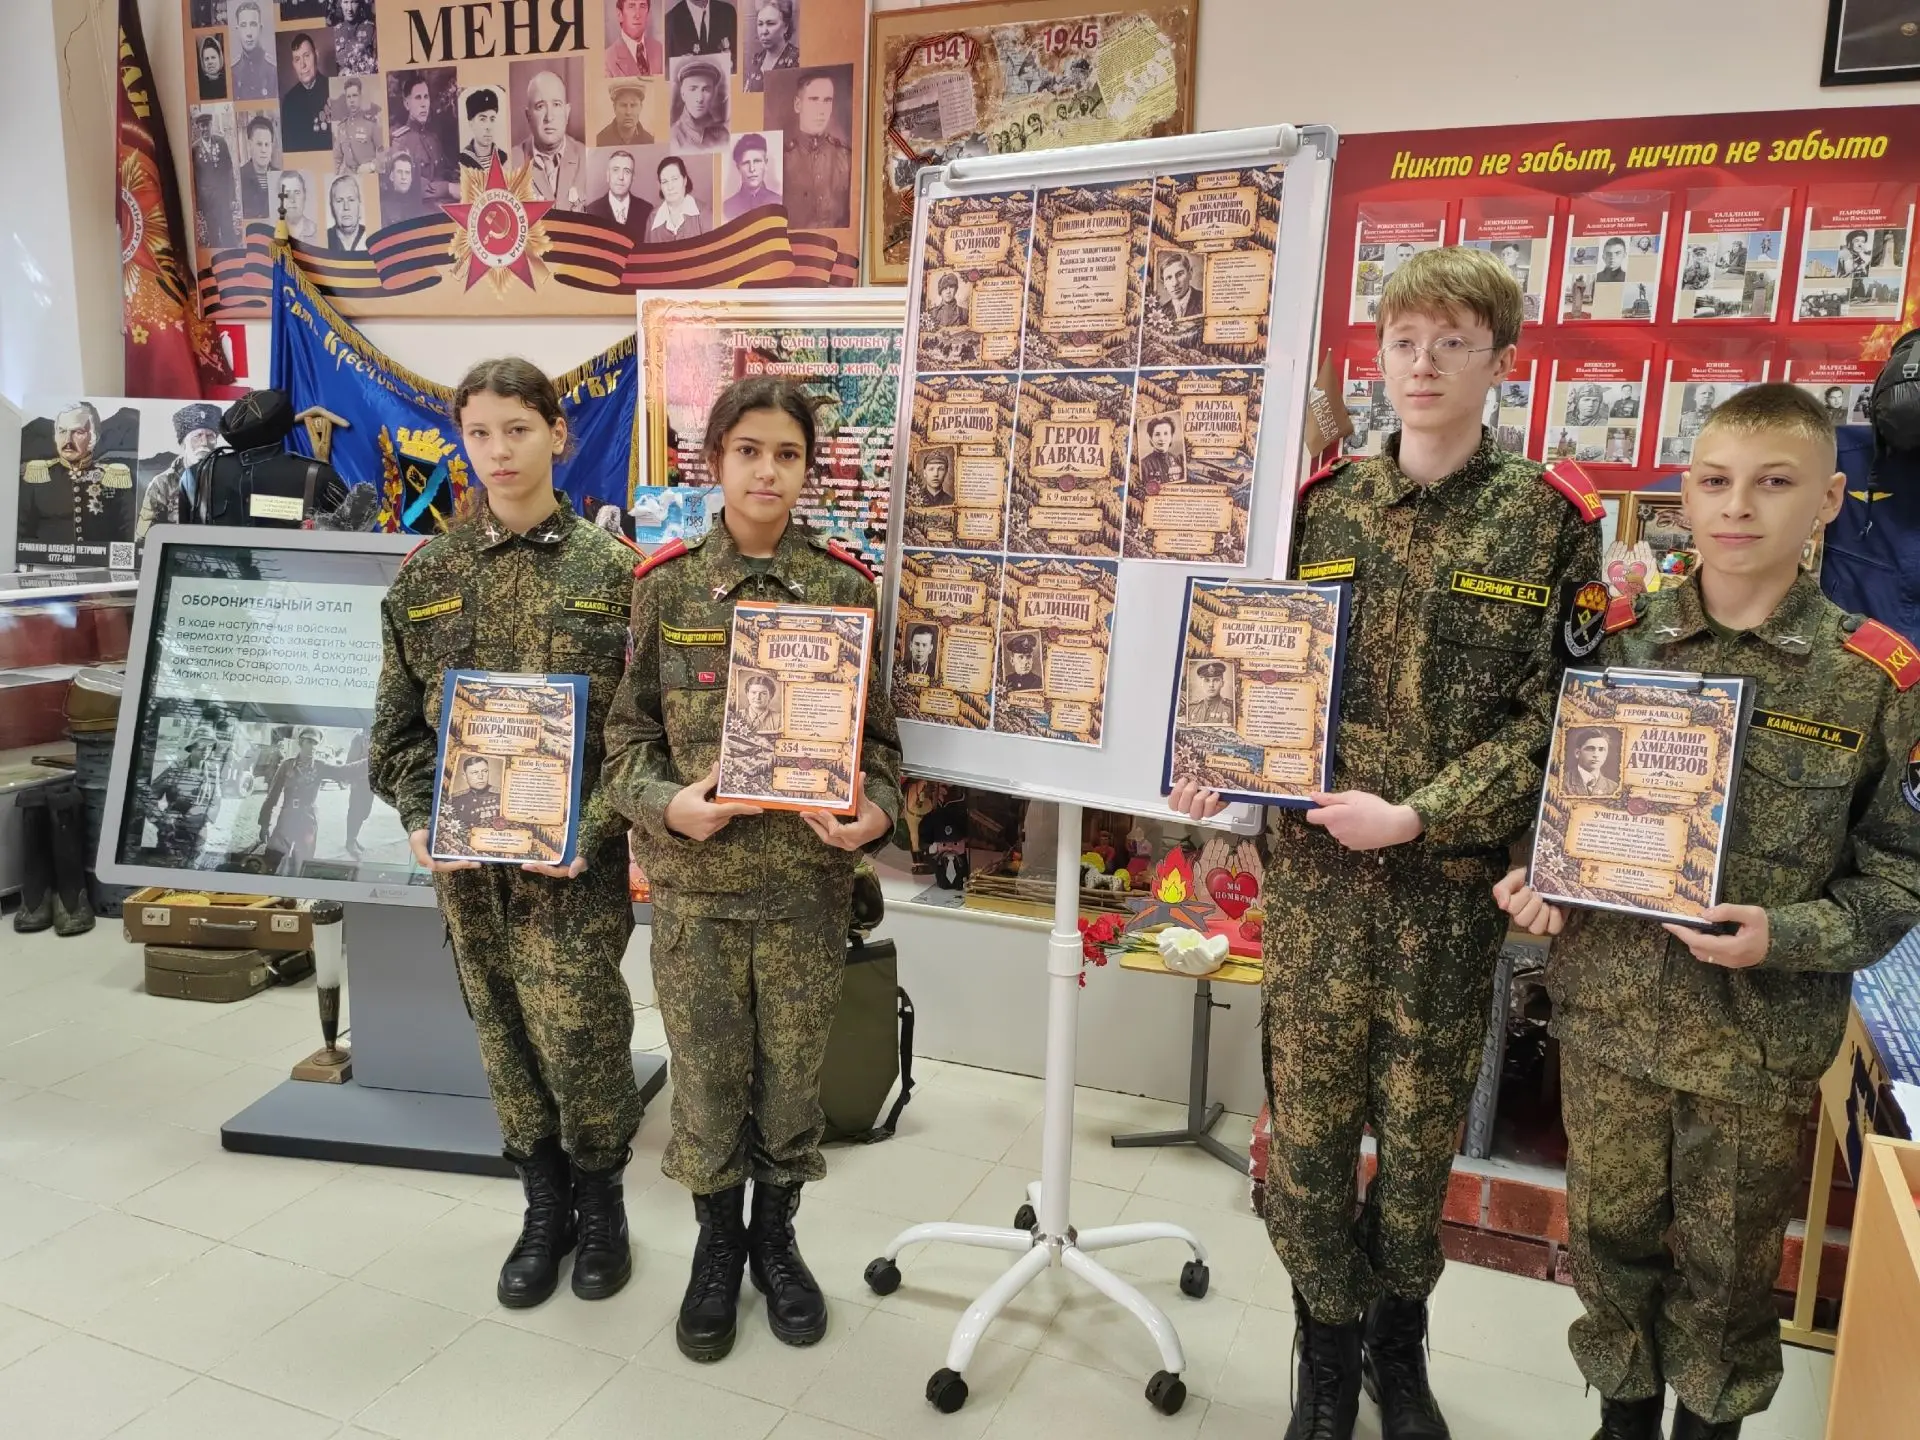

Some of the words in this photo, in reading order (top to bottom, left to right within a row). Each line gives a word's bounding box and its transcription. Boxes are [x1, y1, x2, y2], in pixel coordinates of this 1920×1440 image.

[403, 0, 590, 64] МЕНЯ
[1043, 24, 1099, 54] 1945
[922, 37, 973, 65] 1941
[1390, 150, 1472, 180] Никто
[1479, 150, 1511, 177] не
[1517, 142, 1618, 176] забыт,
[1627, 138, 1718, 169] ничто
[1724, 135, 1760, 165] не
[1767, 128, 1890, 163] забыто
[1198, 192, 1237, 202] АЛЕКСАНДР
[1189, 201, 1243, 211] ПОЛИКАРПОВИЧ
[1056, 219, 1085, 232] ПОМНИМ
[1086, 219, 1092, 228] И
[1092, 216, 1127, 228] ГОРДИМСЯ
[1180, 210, 1251, 232] КИРИЧЕНКО
[510, 216, 526, 257] ВОЙНА
[950, 229, 975, 239] ЦЕЗАРЬ
[976, 226, 1007, 237] ЛЬВОВИЧ
[955, 237, 1001, 252] КУНИКОВ
[1057, 248, 1081, 257] Подвиг
[1060, 257, 1085, 265] Кавказа
[1087, 256, 1116, 265] навсегда
[1058, 266, 1088, 275] останется
[1095, 265, 1116, 273] нашей
[726, 332, 777, 352] «Пусть
[781, 336, 814, 352] один
[819, 335, 828, 348] я
[832, 336, 889, 352] погибну
[746, 363, 763, 374] но
[767, 362, 839, 374] останется
[842, 362, 882, 374] жить
[938, 406, 953, 415] ПЁТР
[1195, 400, 1234, 410] МАГУБА
[932, 416, 994, 432] БАРБАШОВ
[1186, 411, 1242, 422] ГУСЕЙНОВНА
[1311, 401, 1331, 442] ПОБЕДЫ
[1320, 394, 1339, 439] МУЗЕЙ
[1184, 421, 1243, 433] СЫРТЛАНОВА
[1044, 426, 1100, 446] ГЕРОИ
[1035, 446, 1105, 467] КАВКАЗА
[1046, 493, 1052, 501] К
[1054, 493, 1058, 502] 9
[1060, 493, 1088, 502] октября
[48, 544, 75, 554] АЛЕКСЕЙ
[76, 546, 107, 555] ПЕТРОВИЧ
[921, 581, 948, 590] ГЕННАДИЙ
[950, 584, 980, 594] ПЕТРОВИЧ
[1460, 576, 1513, 597] МЕДЯНИК
[1517, 587, 1538, 601] Е.Н.
[181, 594, 313, 611] ОБОРОНИТЕЛЬНЫЙ
[315, 600, 353, 613] ЭТАП
[925, 592, 973, 605] ИГНАТОВ
[1027, 592, 1055, 601] ДМИТРИЙ
[1055, 592, 1090, 602] СЕМЁНОВИЧ
[574, 600, 610, 611] ИСКАКОВА
[1024, 602, 1090, 622] КАЛИНИН
[178, 617, 185, 626] В
[189, 618, 216, 629] ходе
[218, 621, 294, 633] наступления
[296, 623, 347, 635] войскам
[1222, 622, 1255, 631] ВАСИЛИЙ
[1258, 624, 1303, 635] АНДРЕЕВИЧ
[176, 631, 233, 643] вермахта
[236, 635, 284, 646] удалось
[287, 637, 346, 649] захватить
[349, 639, 382, 650] часть
[766, 633, 798, 642] ЕВДОКИЯ
[798, 635, 833, 646] ИВАНОВНА
[1226, 632, 1296, 649] БОТЫЛЁВ
[312, 650, 319, 659] В
[768, 643, 830, 661] НОСАЛЬ
[1886, 646, 1913, 672] КК
[173, 657, 234, 668] оказались
[236, 659, 311, 673] Ставрополь,
[313, 664, 371, 676] Армавир,
[222, 671, 292, 685] Краснодар,
[295, 675, 341, 688] Элиста,
[469, 714, 505, 724] АЛЕКСАНДР
[506, 717, 539, 725] ИВАНОВИЧ
[1622, 708, 1647, 717] ГЕРОИ
[1648, 710, 1684, 721] КАВКАЗА
[467, 722, 538, 740] ПОКРЫШКИН
[1639, 727, 1706, 745] АЙДАМИР
[1766, 716, 1820, 737] КАМЫНИН
[1822, 730, 1843, 743] А.И.
[780, 742, 799, 753] 354
[1631, 742, 1709, 758] АХМЕДОВИЧ
[1278, 752, 1301, 760] ПАМЯТЬ
[1626, 752, 1708, 776] АЧМИЗОВ
[1594, 811, 1629, 822] УЧИТЕЛЬ
[1640, 817, 1665, 826] ГЕРОЙ
[1616, 868, 1645, 877] ПАМЯТЬ
[1227, 882, 1241, 891] МЫ
[1215, 891, 1253, 903] ПОМНИМ
